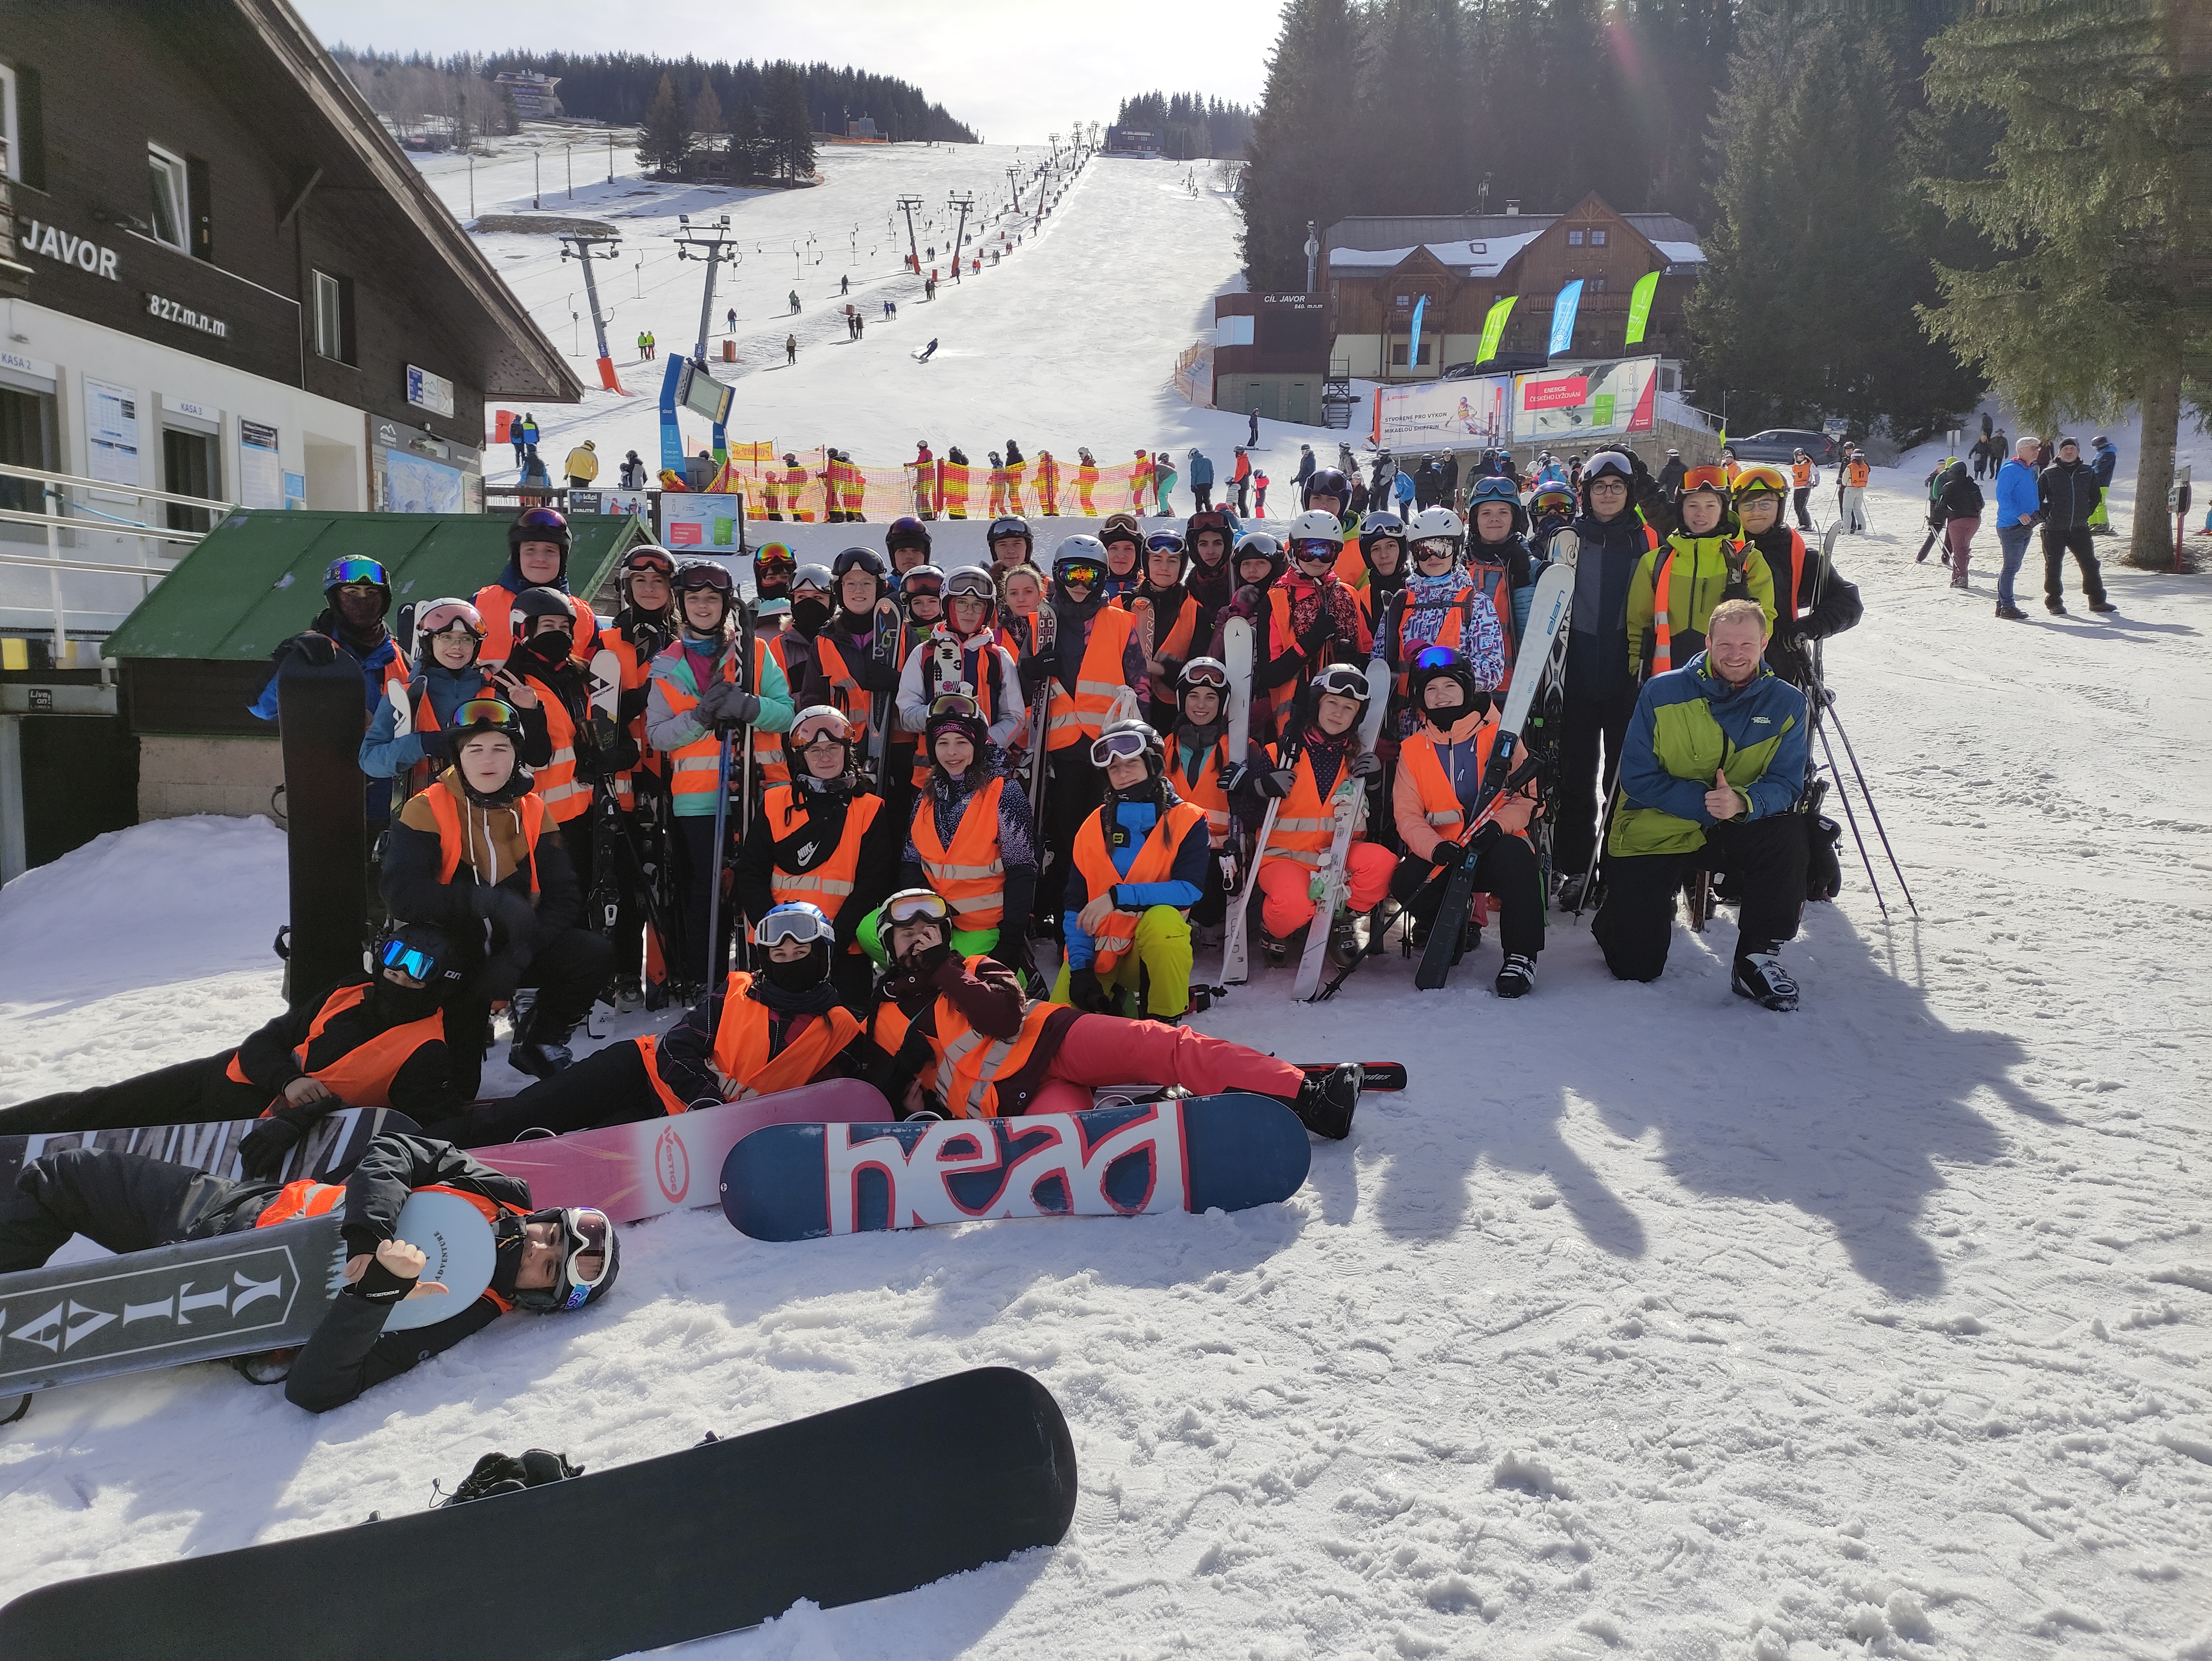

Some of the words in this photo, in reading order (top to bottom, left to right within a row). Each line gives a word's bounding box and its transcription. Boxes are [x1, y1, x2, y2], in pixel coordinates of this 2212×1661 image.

[22, 220, 117, 281] JAVOR
[1264, 294, 1277, 303] CÍL
[150, 295, 226, 337] 827.m.n.m
[1, 353, 24, 367] KASA
[26, 360, 31, 370] 2
[1555, 390, 1582, 399] LYŽOVÁNÍ
[181, 402, 197, 414] KASA
[199, 407, 202, 415] 3
[1384, 413, 1413, 422] STVOŘENÉ
[583, 493, 598, 502] kilpi
[1558, 545, 1578, 650] ATOIC
[1547, 589, 1565, 635] elan
[1145, 608, 1155, 660] ZZARD
[592, 686, 614, 699] FISCHER
[1475, 828, 1486, 838] reusch
[797, 841, 815, 860] NIKE
[663, 1125, 677, 1192] VESTIGE
[826, 1101, 1191, 1236] head
[433, 1231, 448, 1282] ADVENTURE
